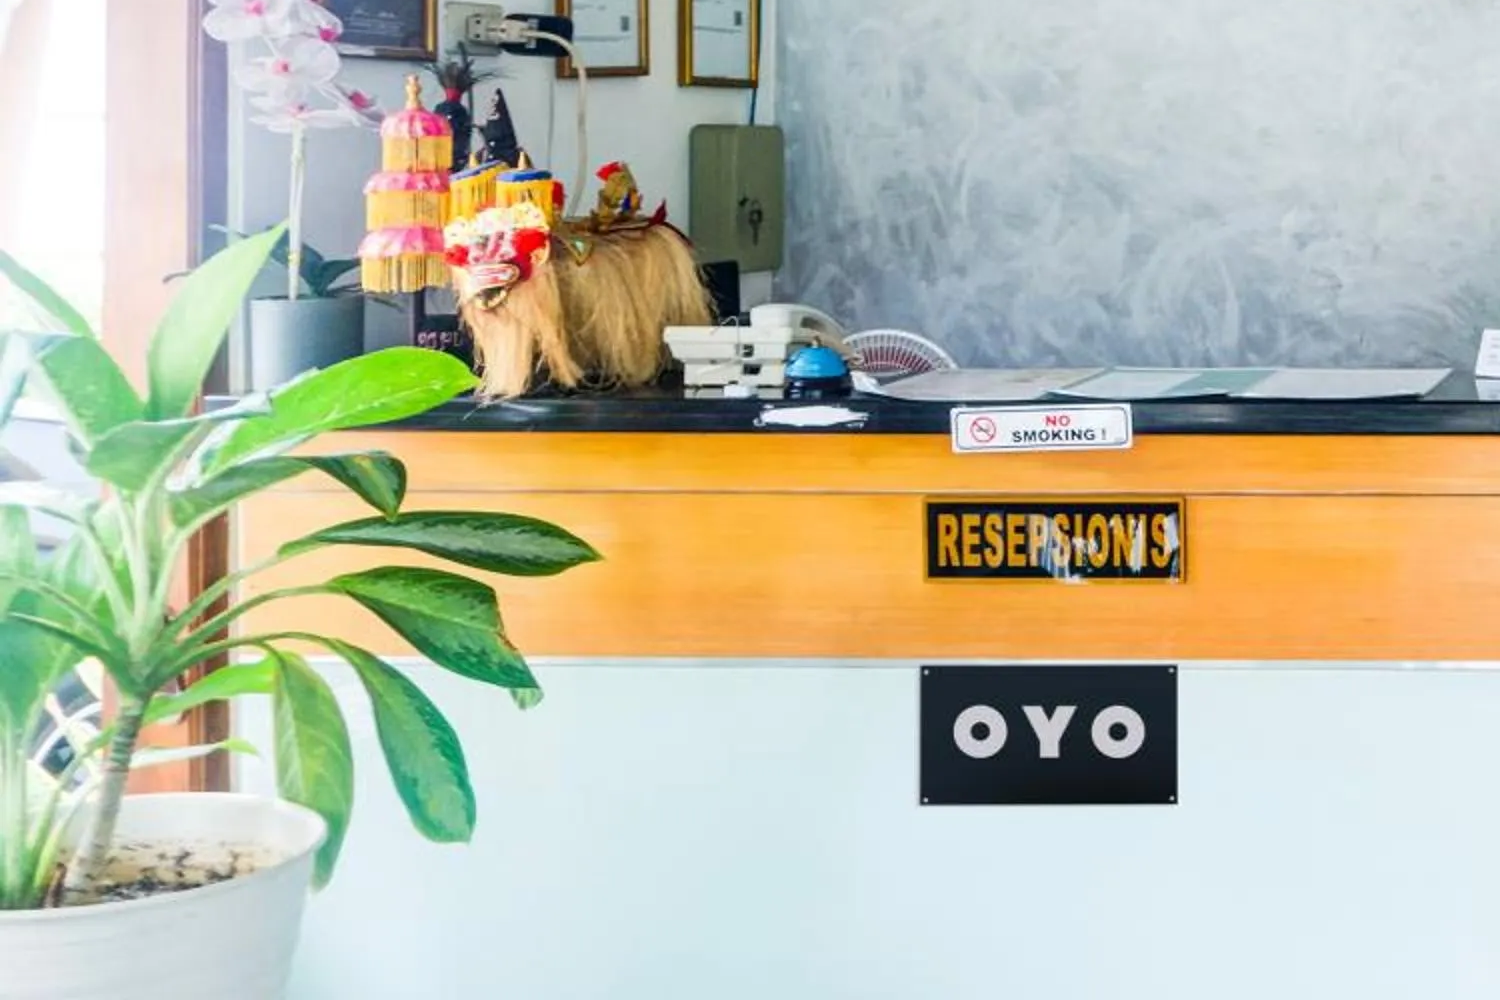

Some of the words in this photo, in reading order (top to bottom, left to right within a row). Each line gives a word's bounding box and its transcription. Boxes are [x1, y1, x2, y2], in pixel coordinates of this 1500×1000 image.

[1012, 429, 1096, 443] SMOKING
[1045, 415, 1071, 427] NO
[937, 513, 1174, 568] RESEPSIONIS
[953, 705, 1145, 759] OYO
